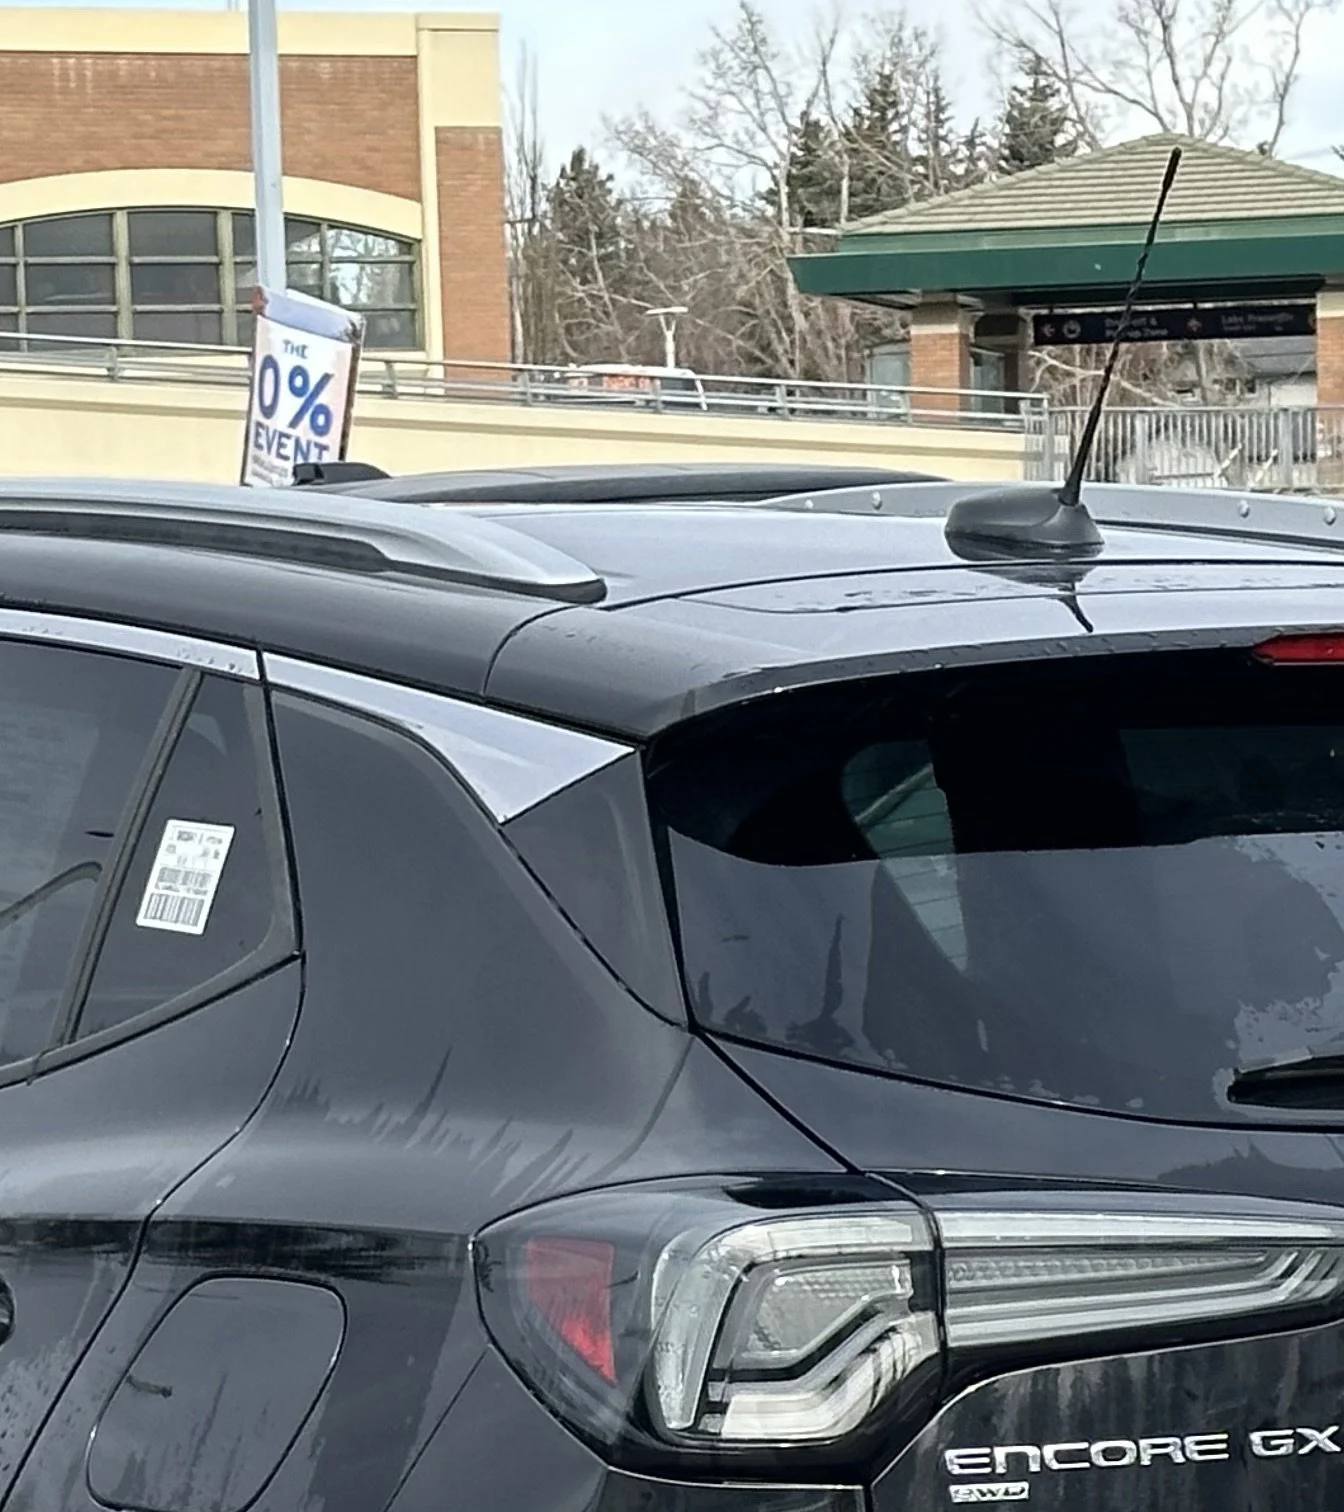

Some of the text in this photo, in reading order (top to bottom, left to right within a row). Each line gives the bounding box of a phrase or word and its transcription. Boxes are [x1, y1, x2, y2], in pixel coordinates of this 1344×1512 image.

[283, 339, 309, 359] THE
[258, 354, 334, 437] 0%
[254, 421, 330, 463] EVENT
[944, 1425, 1342, 1474] ENCORE GX
